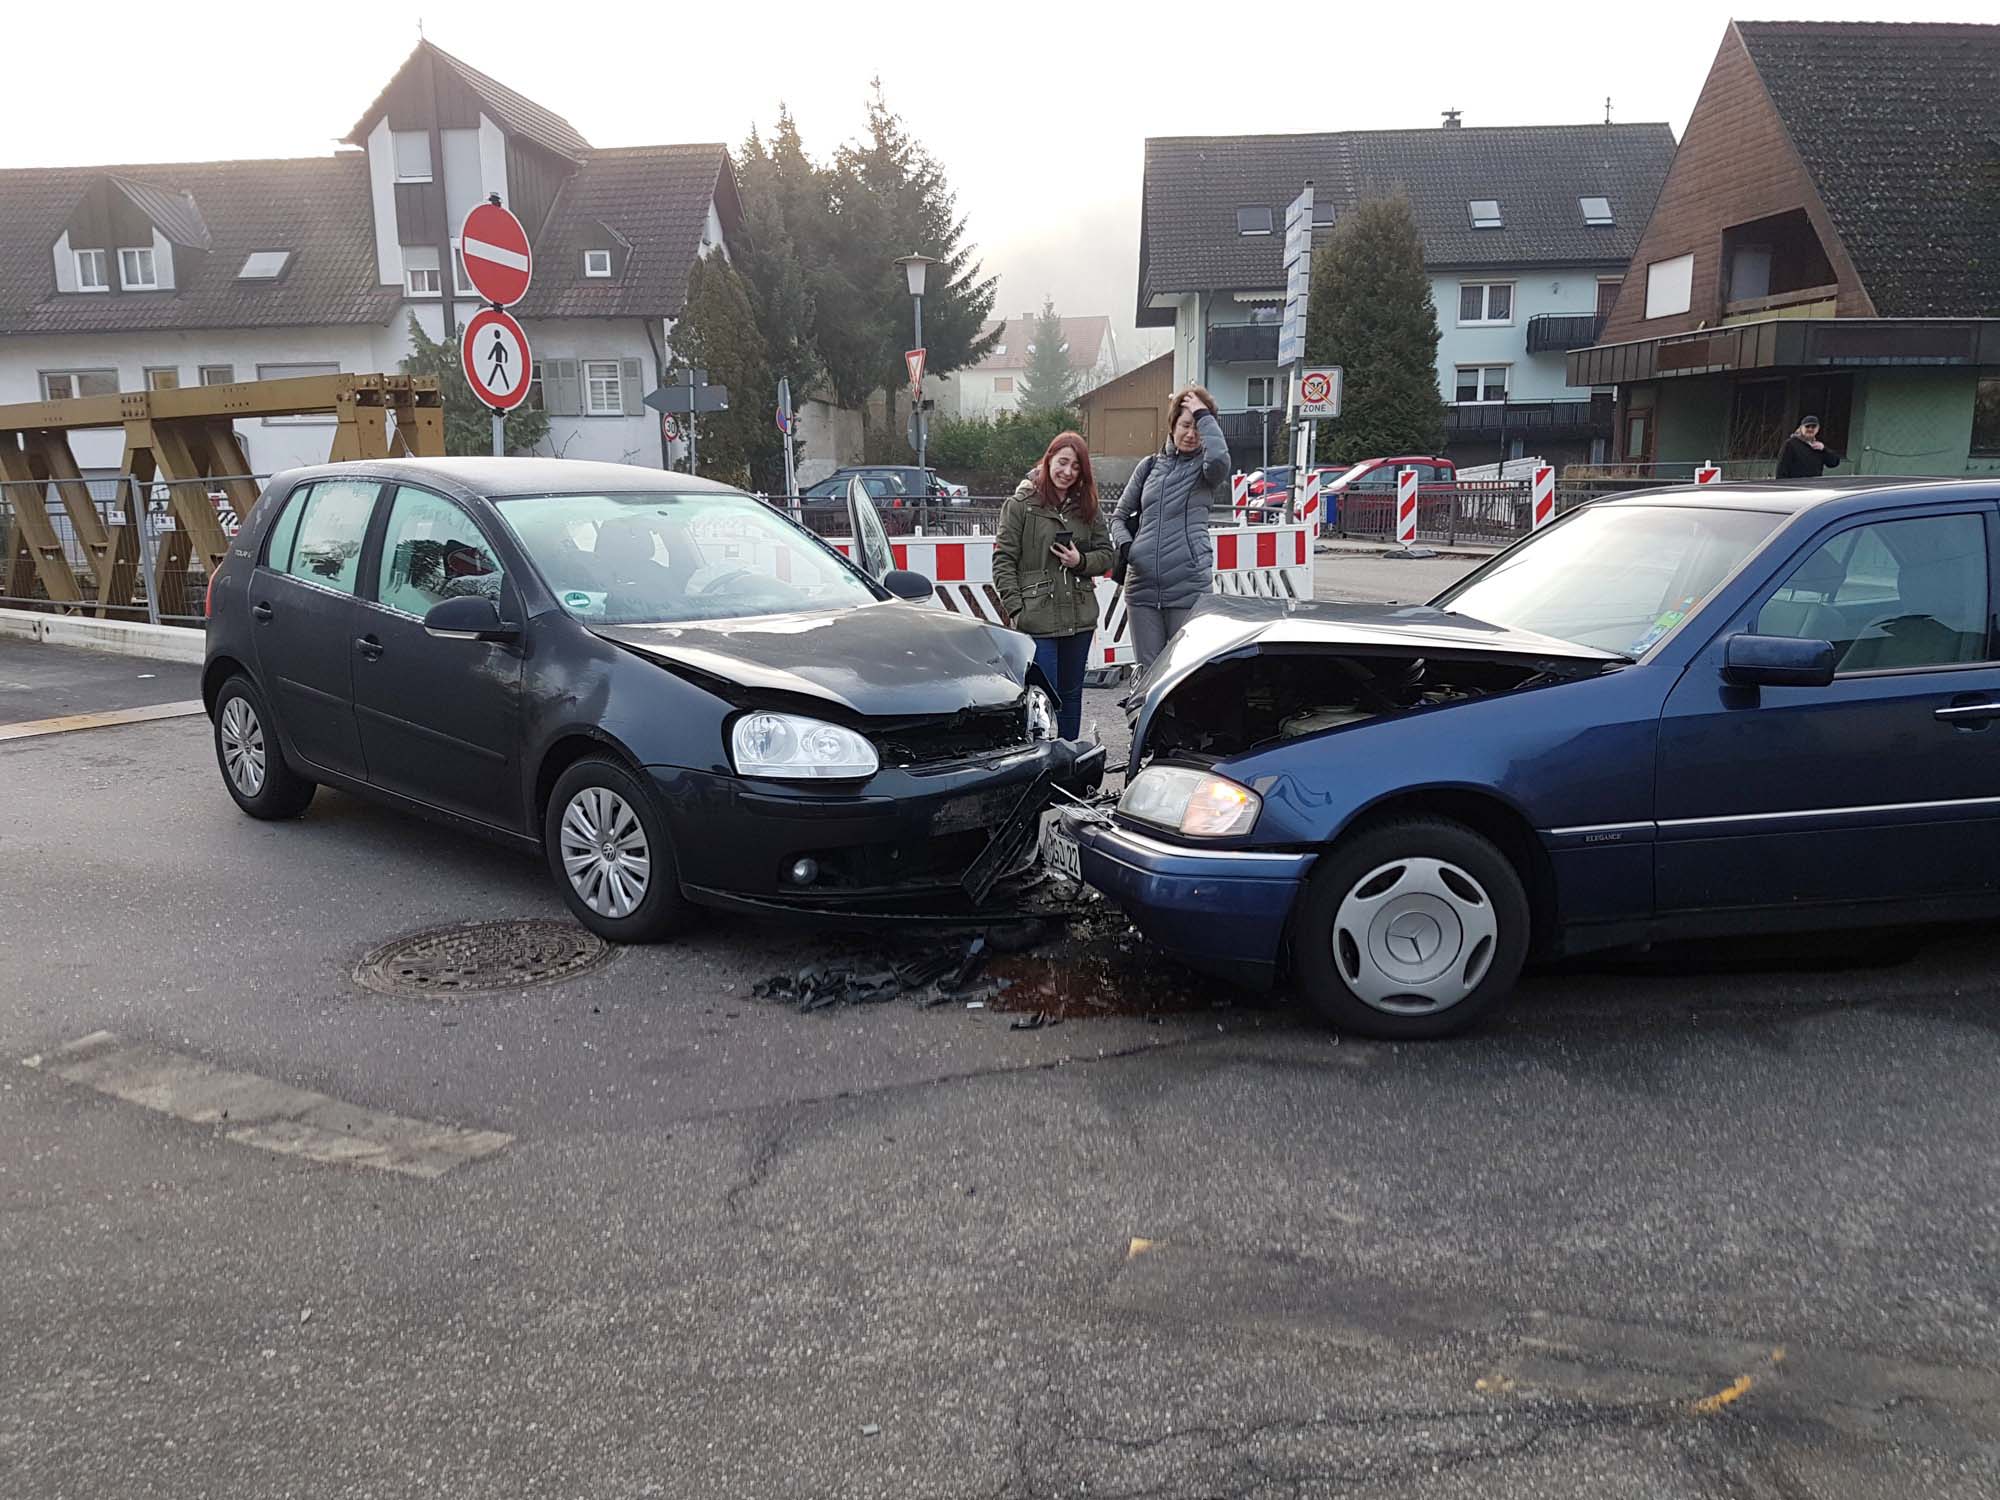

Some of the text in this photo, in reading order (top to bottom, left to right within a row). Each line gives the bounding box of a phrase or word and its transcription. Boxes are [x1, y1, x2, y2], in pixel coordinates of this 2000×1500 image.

[1303, 404, 1327, 413] ZONE
[666, 420, 675, 433] 30
[1585, 833, 1622, 842] ELEGANCE
[1067, 845, 1079, 876] 22
